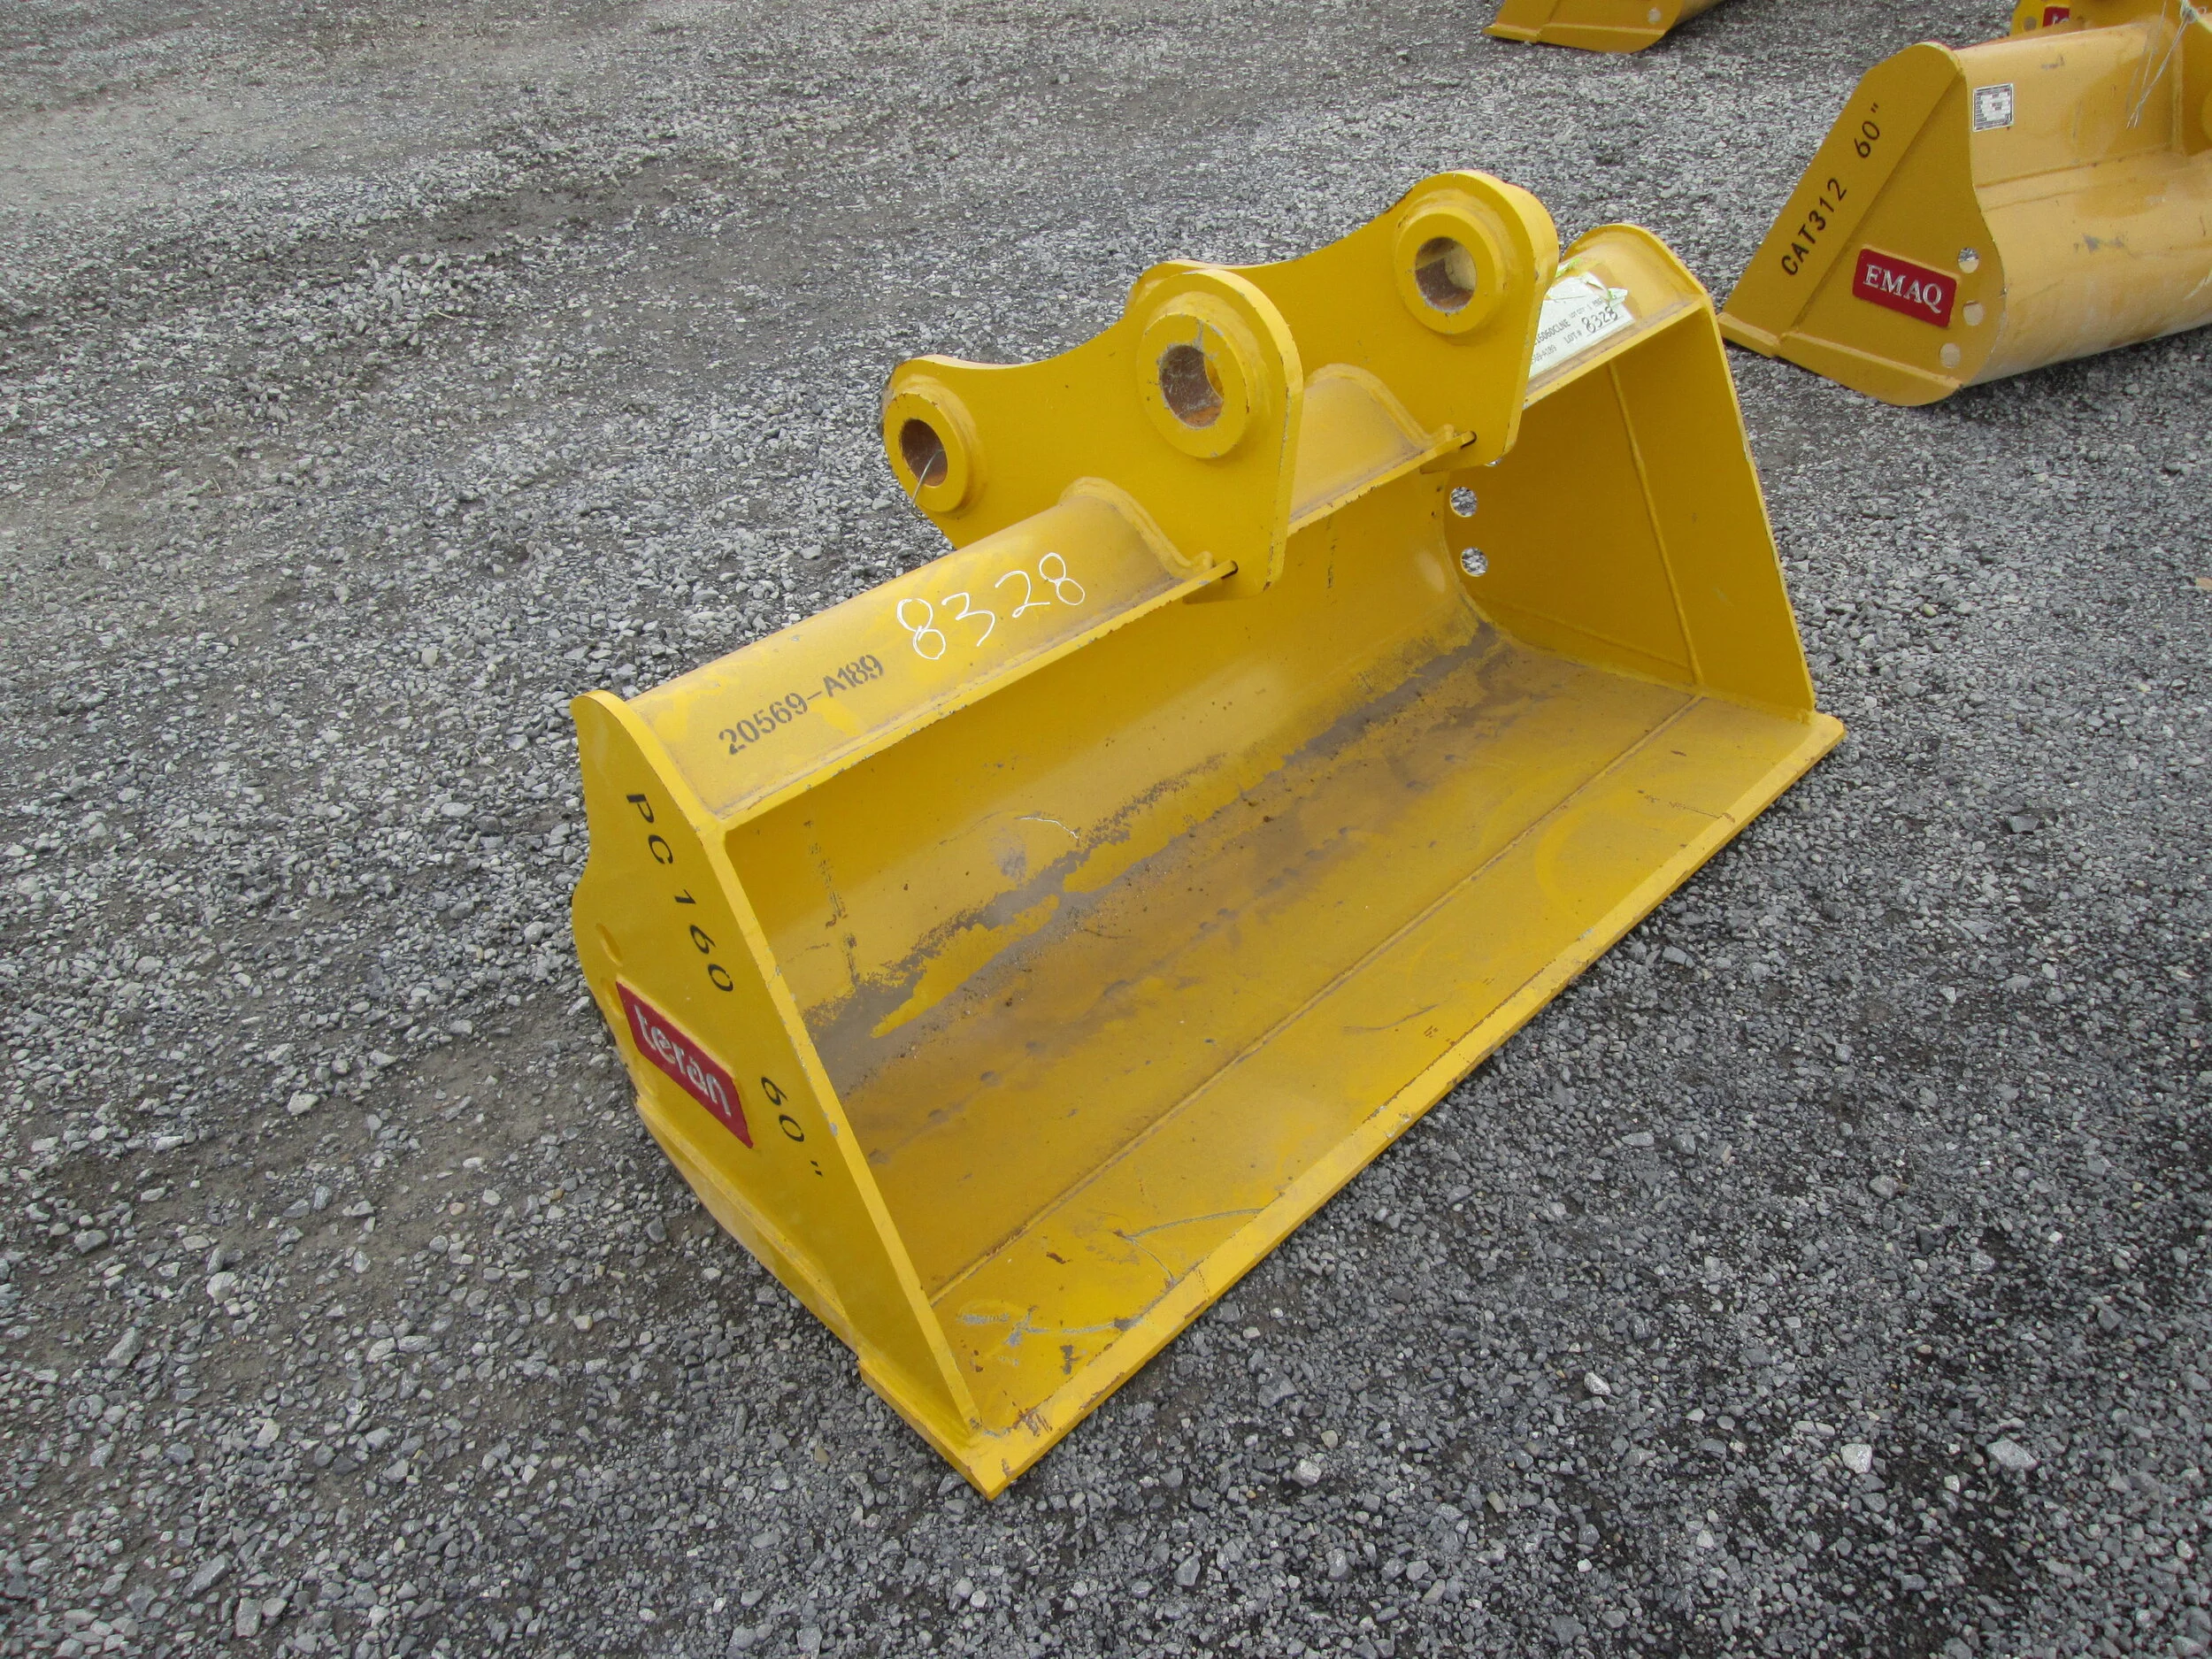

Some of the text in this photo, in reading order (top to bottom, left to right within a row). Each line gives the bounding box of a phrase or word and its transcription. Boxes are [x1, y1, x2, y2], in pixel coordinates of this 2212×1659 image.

[1781, 178, 1847, 276] CAT312
[1581, 306, 1618, 334] 8328
[1863, 264, 1942, 314] EMAQ
[896, 552, 1086, 659] 8328
[718, 653, 884, 755] 20569-A189
[633, 1003, 732, 1118] teran
